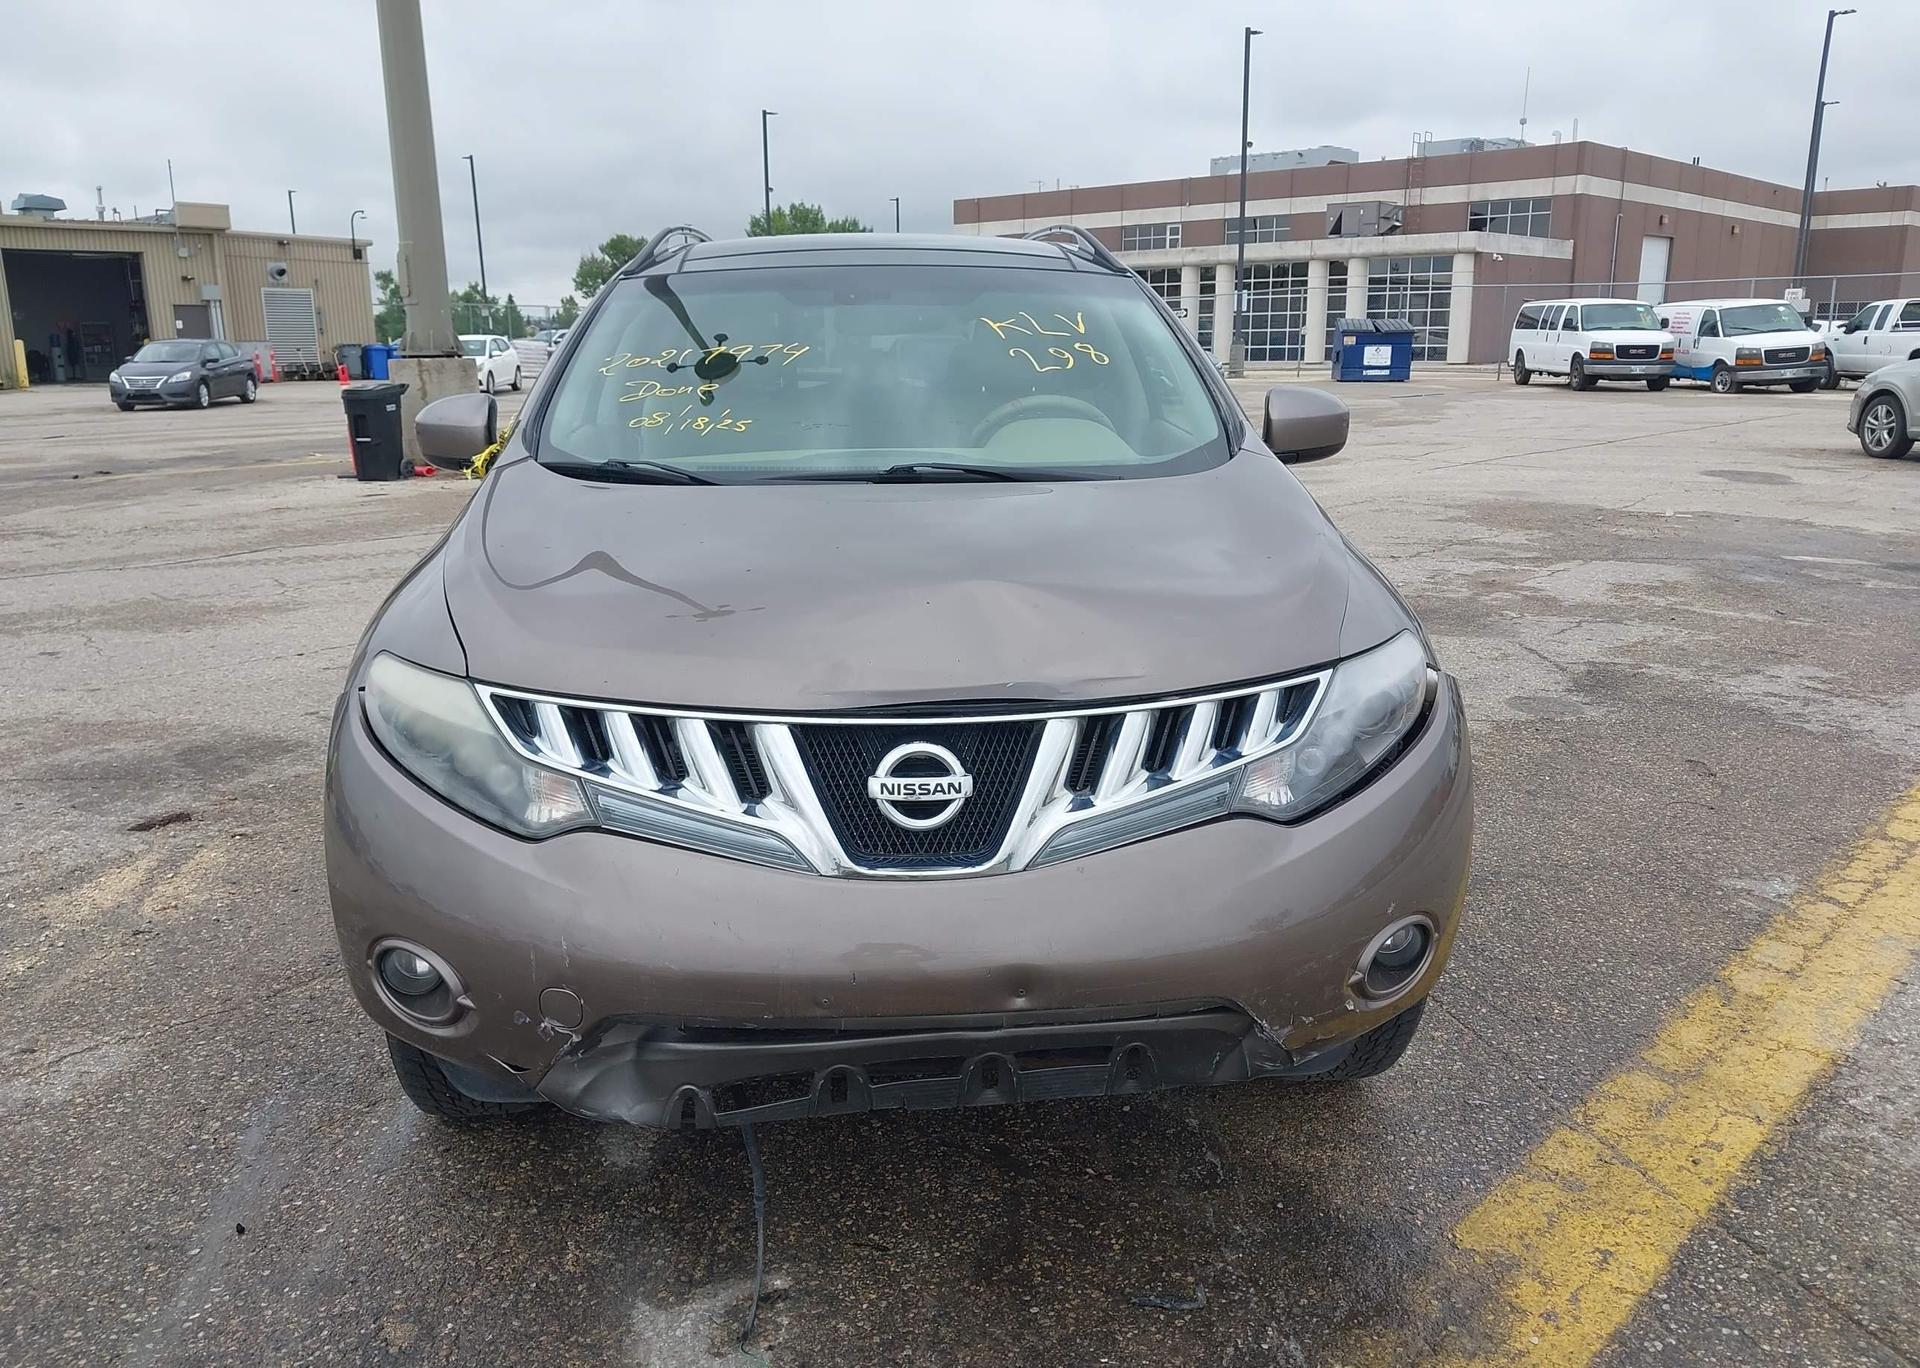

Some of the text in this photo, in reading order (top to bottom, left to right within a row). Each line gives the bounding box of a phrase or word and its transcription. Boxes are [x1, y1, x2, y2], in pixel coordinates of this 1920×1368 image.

[979, 311, 1086, 340] KLV
[1009, 341, 1110, 373] 298
[619, 380, 720, 402] Done
[880, 781, 962, 796] NISSAN
